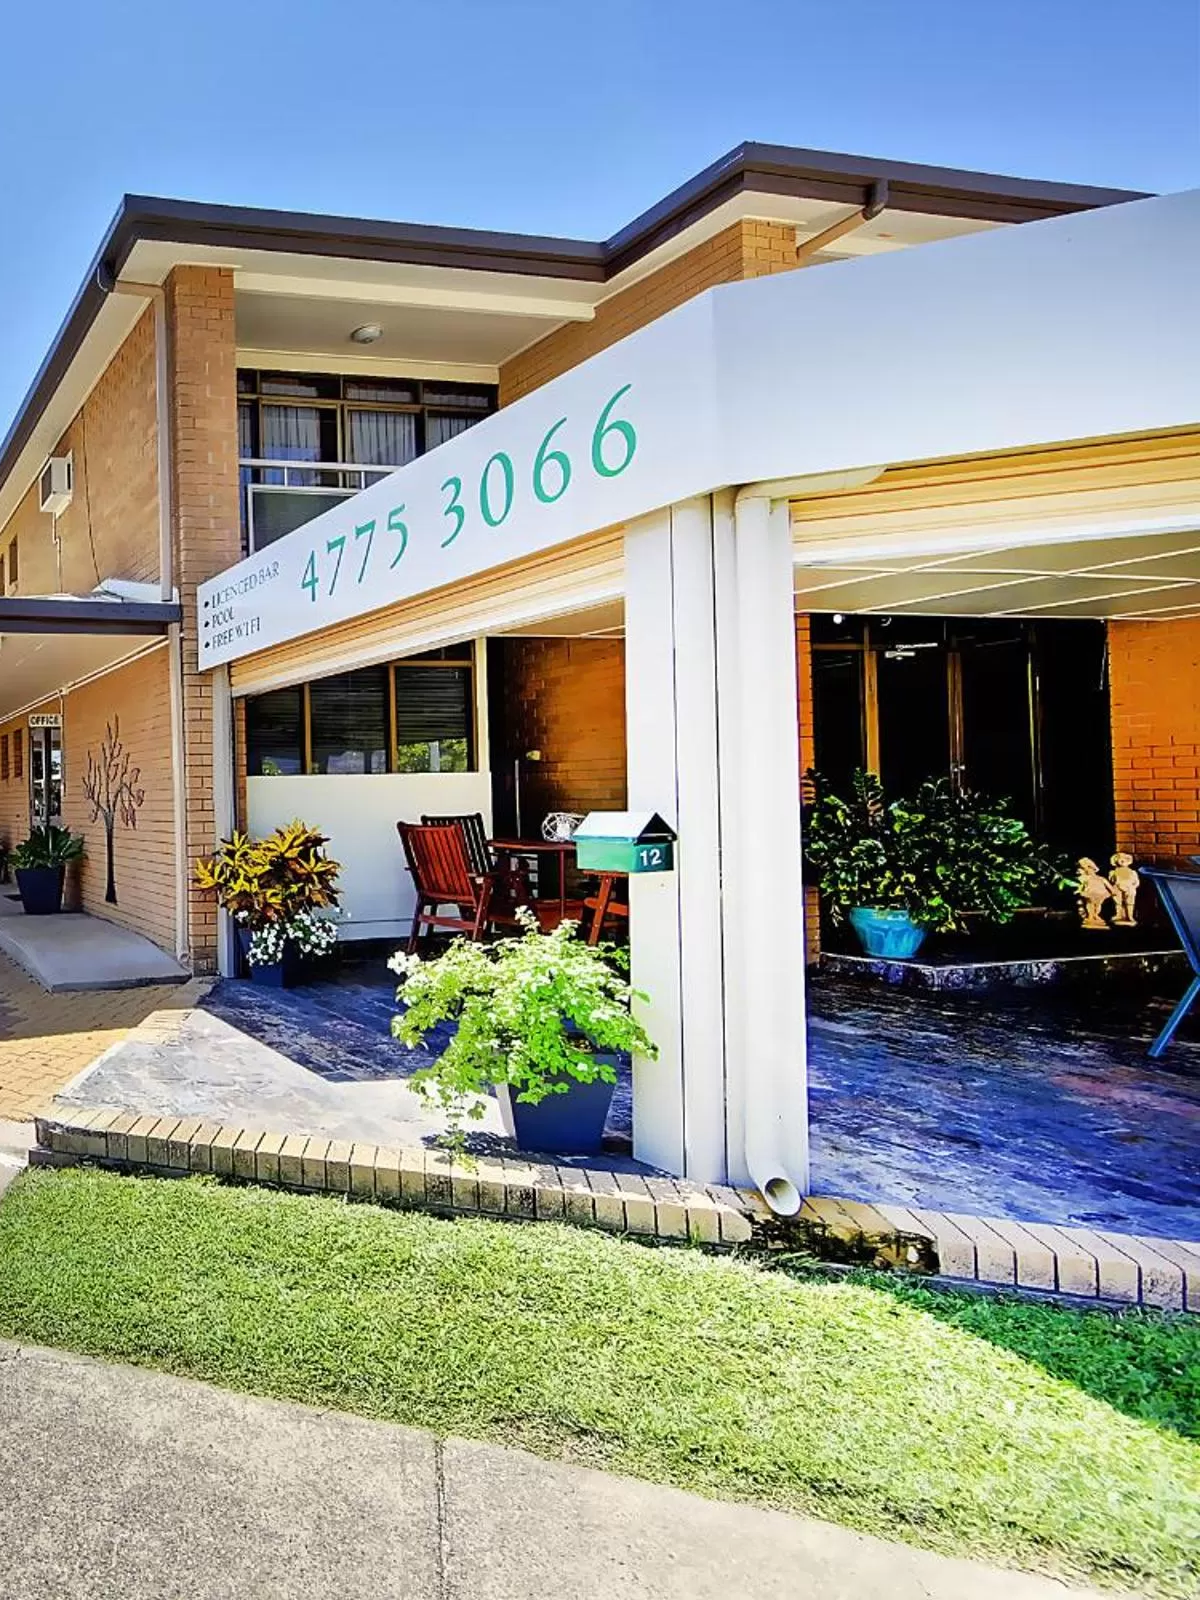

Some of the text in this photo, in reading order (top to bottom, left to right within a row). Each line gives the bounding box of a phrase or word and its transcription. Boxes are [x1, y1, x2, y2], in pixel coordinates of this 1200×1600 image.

[301, 383, 637, 602] 4775 3066
[212, 627, 234, 650] FREE
[30, 715, 59, 725] OFFICE
[639, 848, 662, 866] 12
